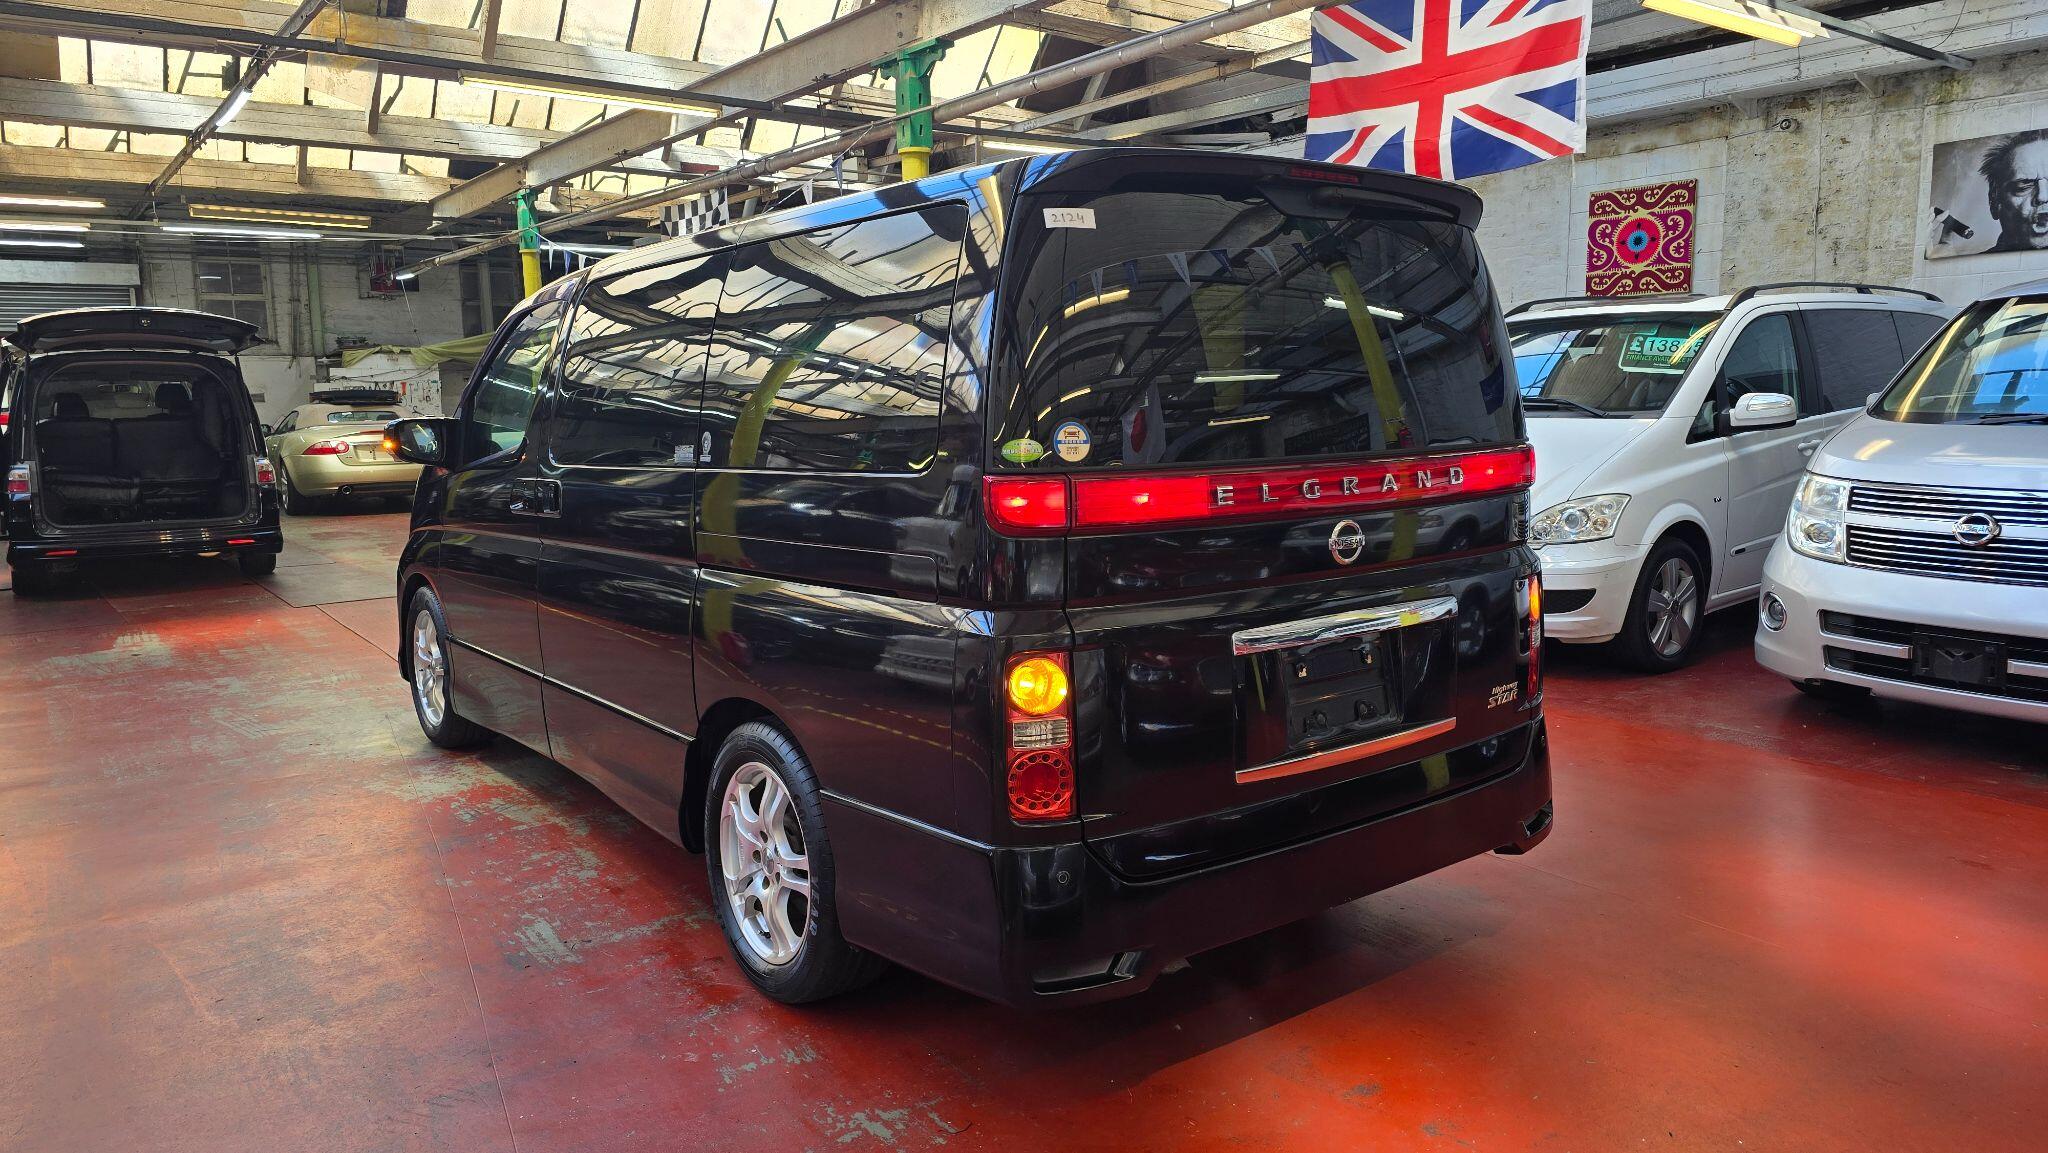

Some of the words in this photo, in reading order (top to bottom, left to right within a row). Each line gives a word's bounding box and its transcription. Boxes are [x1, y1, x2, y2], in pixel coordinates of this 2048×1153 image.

[1051, 212, 1085, 224] 2124
[1216, 466, 1464, 506] ELGRAND
[1331, 536, 1365, 549] NISSAN
[1487, 689, 1518, 709] STAR
